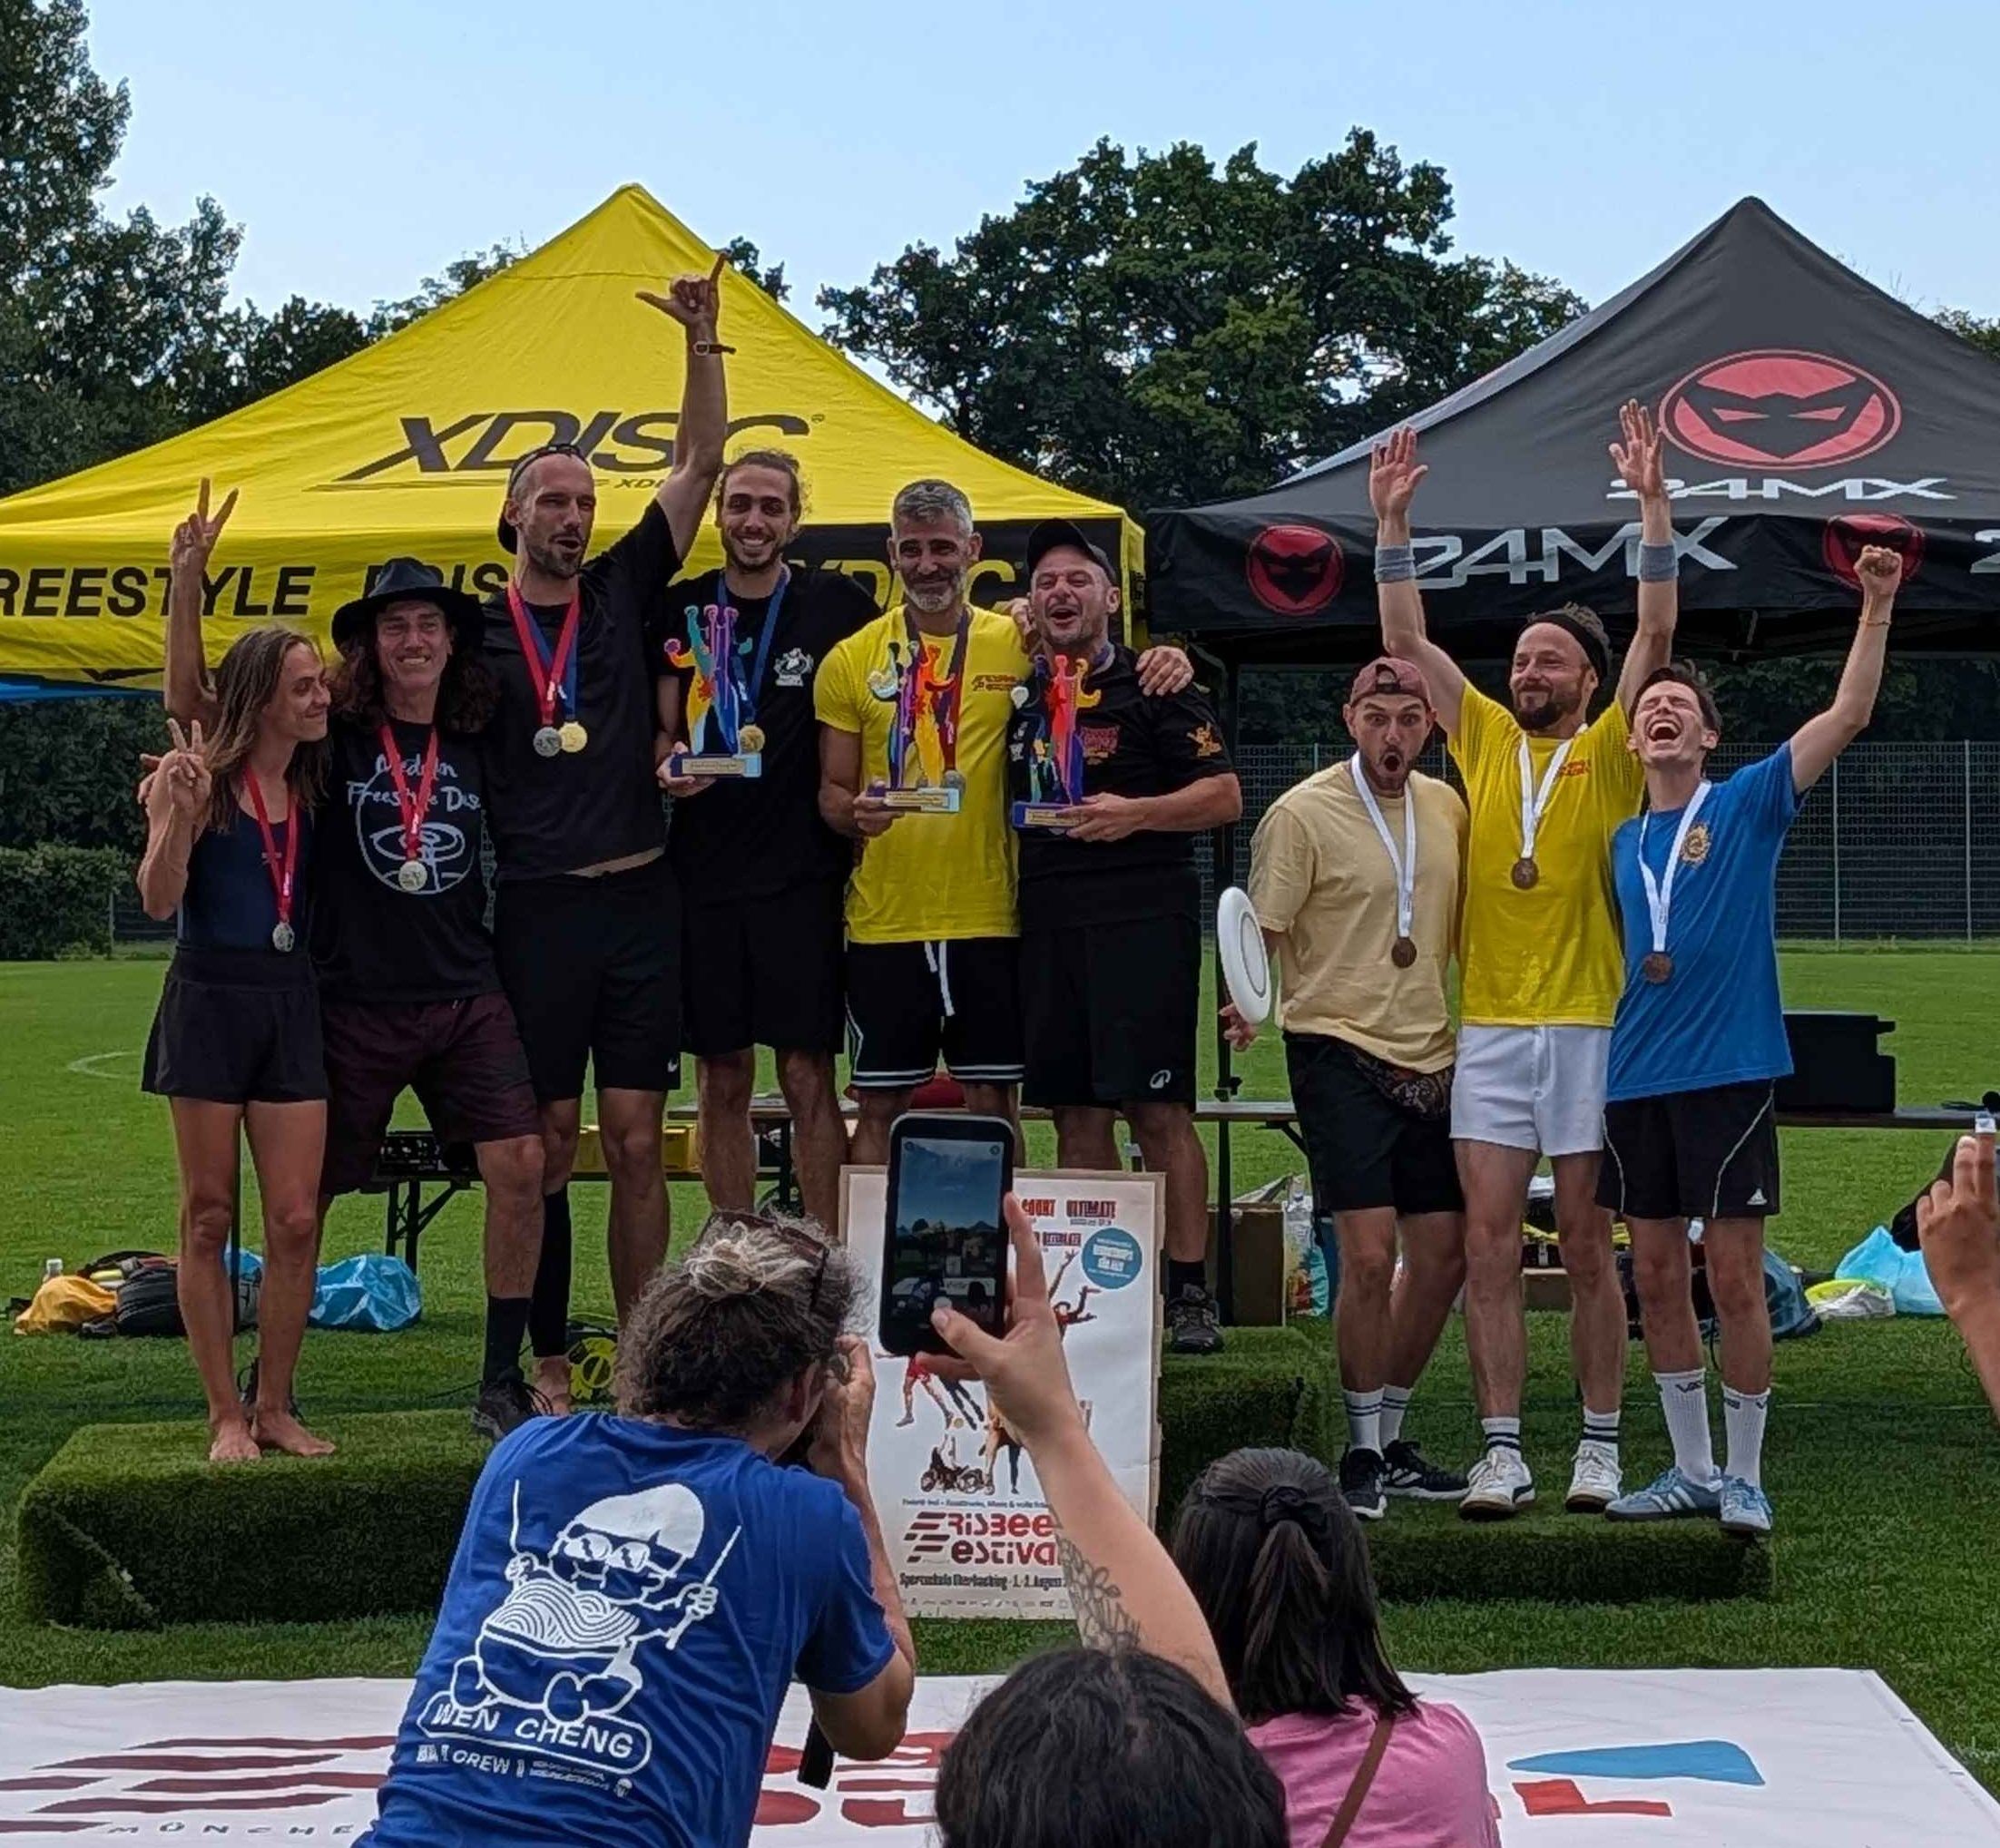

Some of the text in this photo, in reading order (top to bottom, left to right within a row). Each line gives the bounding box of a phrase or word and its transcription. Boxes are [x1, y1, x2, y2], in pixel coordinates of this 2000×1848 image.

[1606, 477, 1957, 501] 24MX
[431, 1704, 633, 1759] WEN CHENG
[452, 1749, 510, 1775] CREW
[107, 1821, 355, 1835] MÜNCHE
